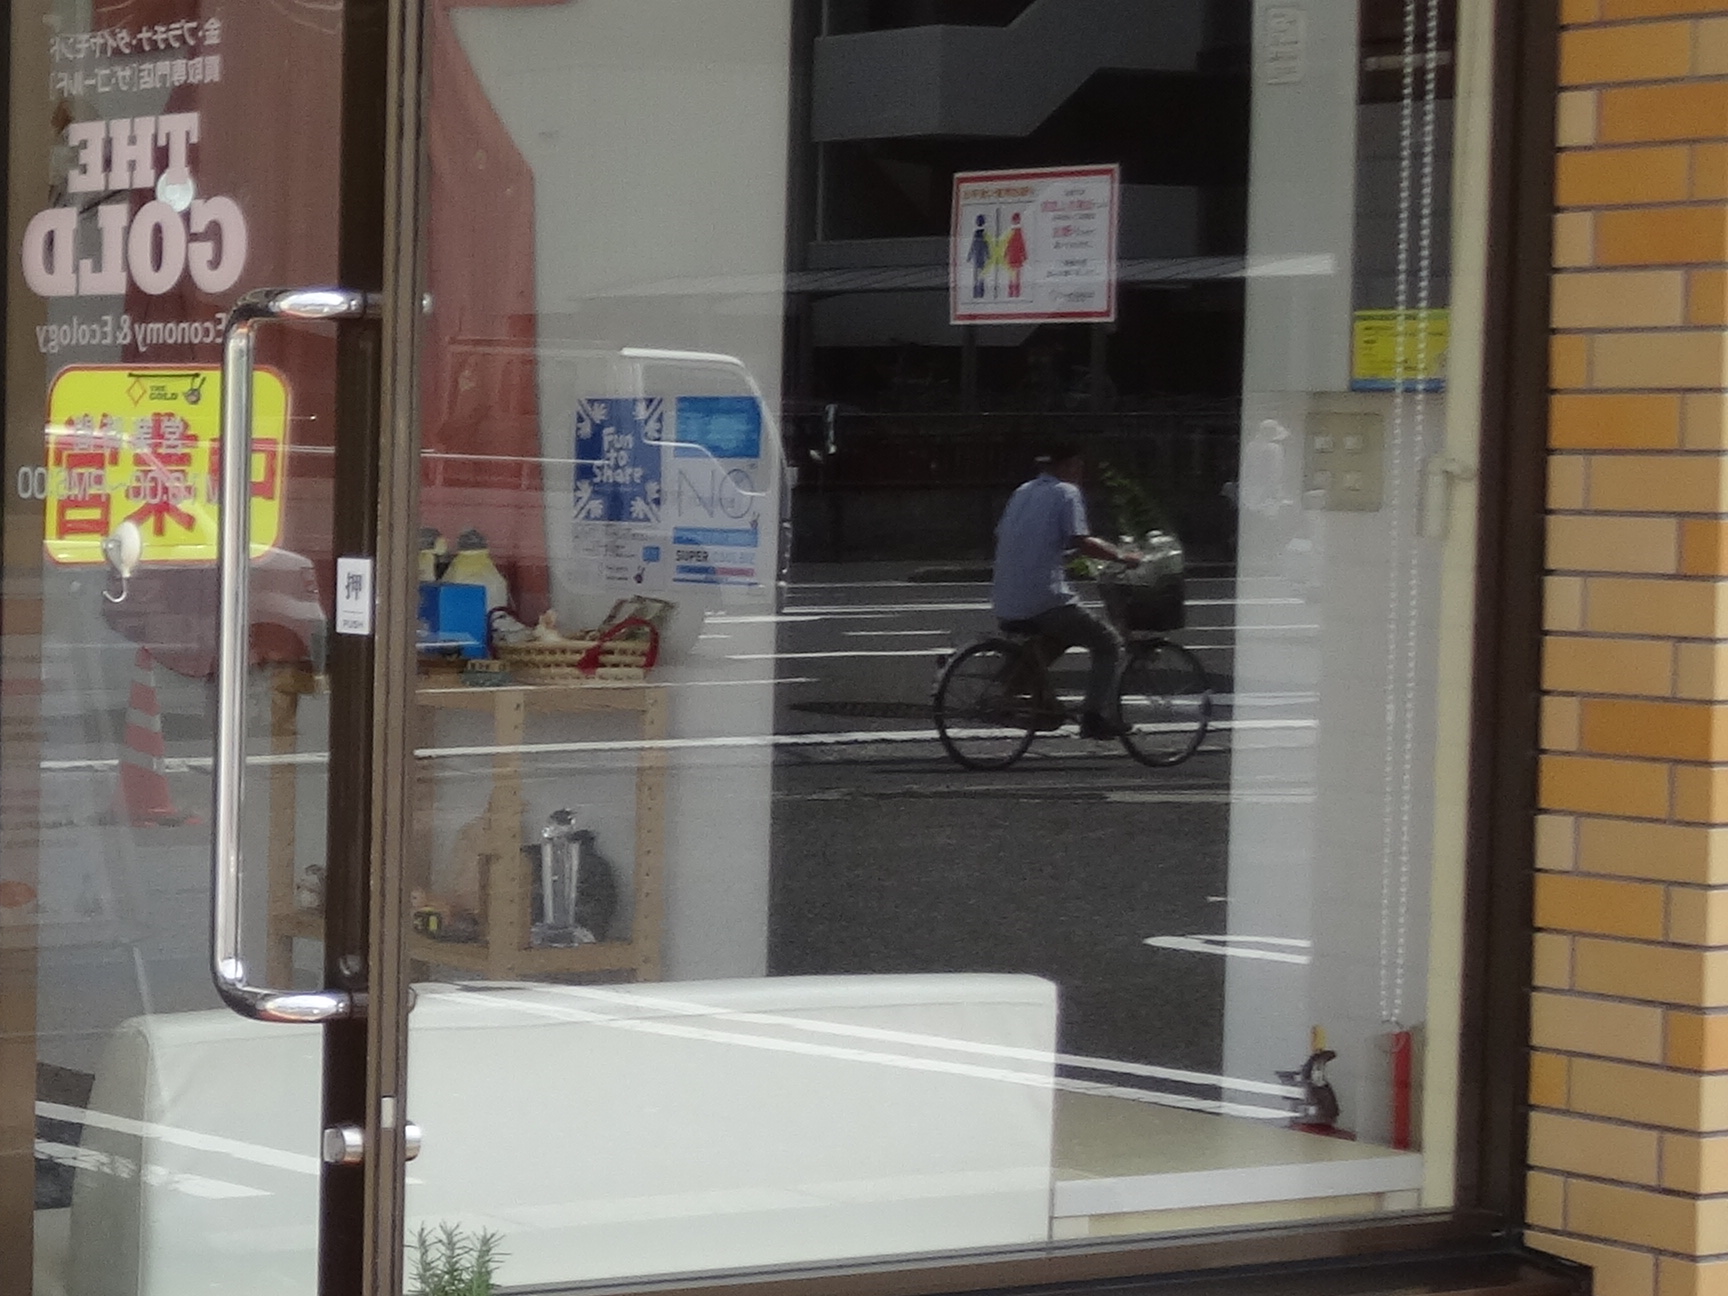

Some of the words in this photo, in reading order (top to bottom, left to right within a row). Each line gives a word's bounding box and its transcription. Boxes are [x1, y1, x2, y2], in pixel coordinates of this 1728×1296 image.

[602, 426, 634, 451] Fun
[675, 549, 710, 562] SUPER
[345, 571, 363, 601] 押
